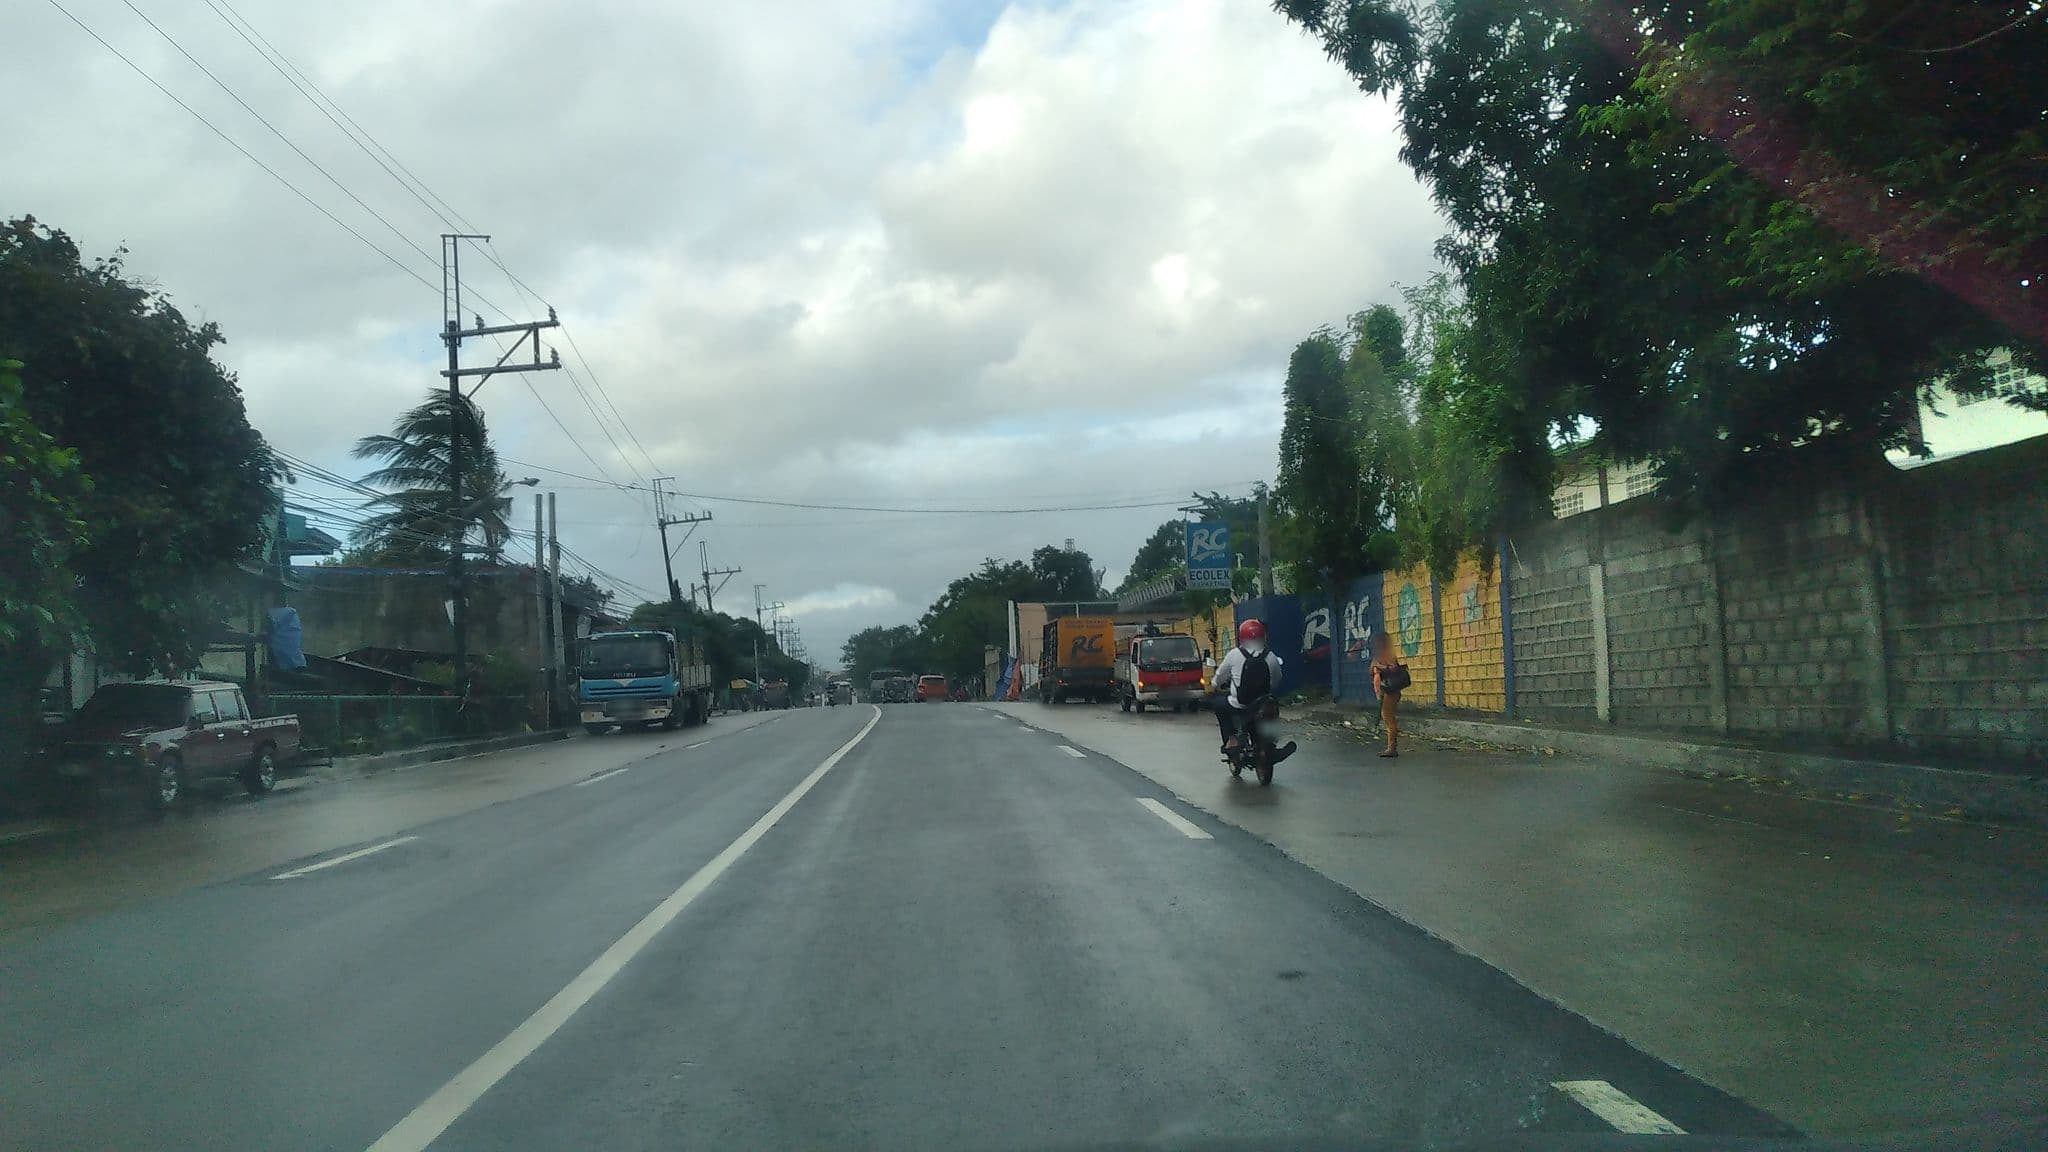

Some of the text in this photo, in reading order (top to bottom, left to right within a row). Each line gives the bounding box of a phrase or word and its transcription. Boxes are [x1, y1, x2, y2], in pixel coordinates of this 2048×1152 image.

[1191, 528, 1227, 558] RC
[1189, 570, 1230, 580] ECOLEX
[1344, 595, 1371, 652] RC
[1072, 633, 1104, 656] RC
